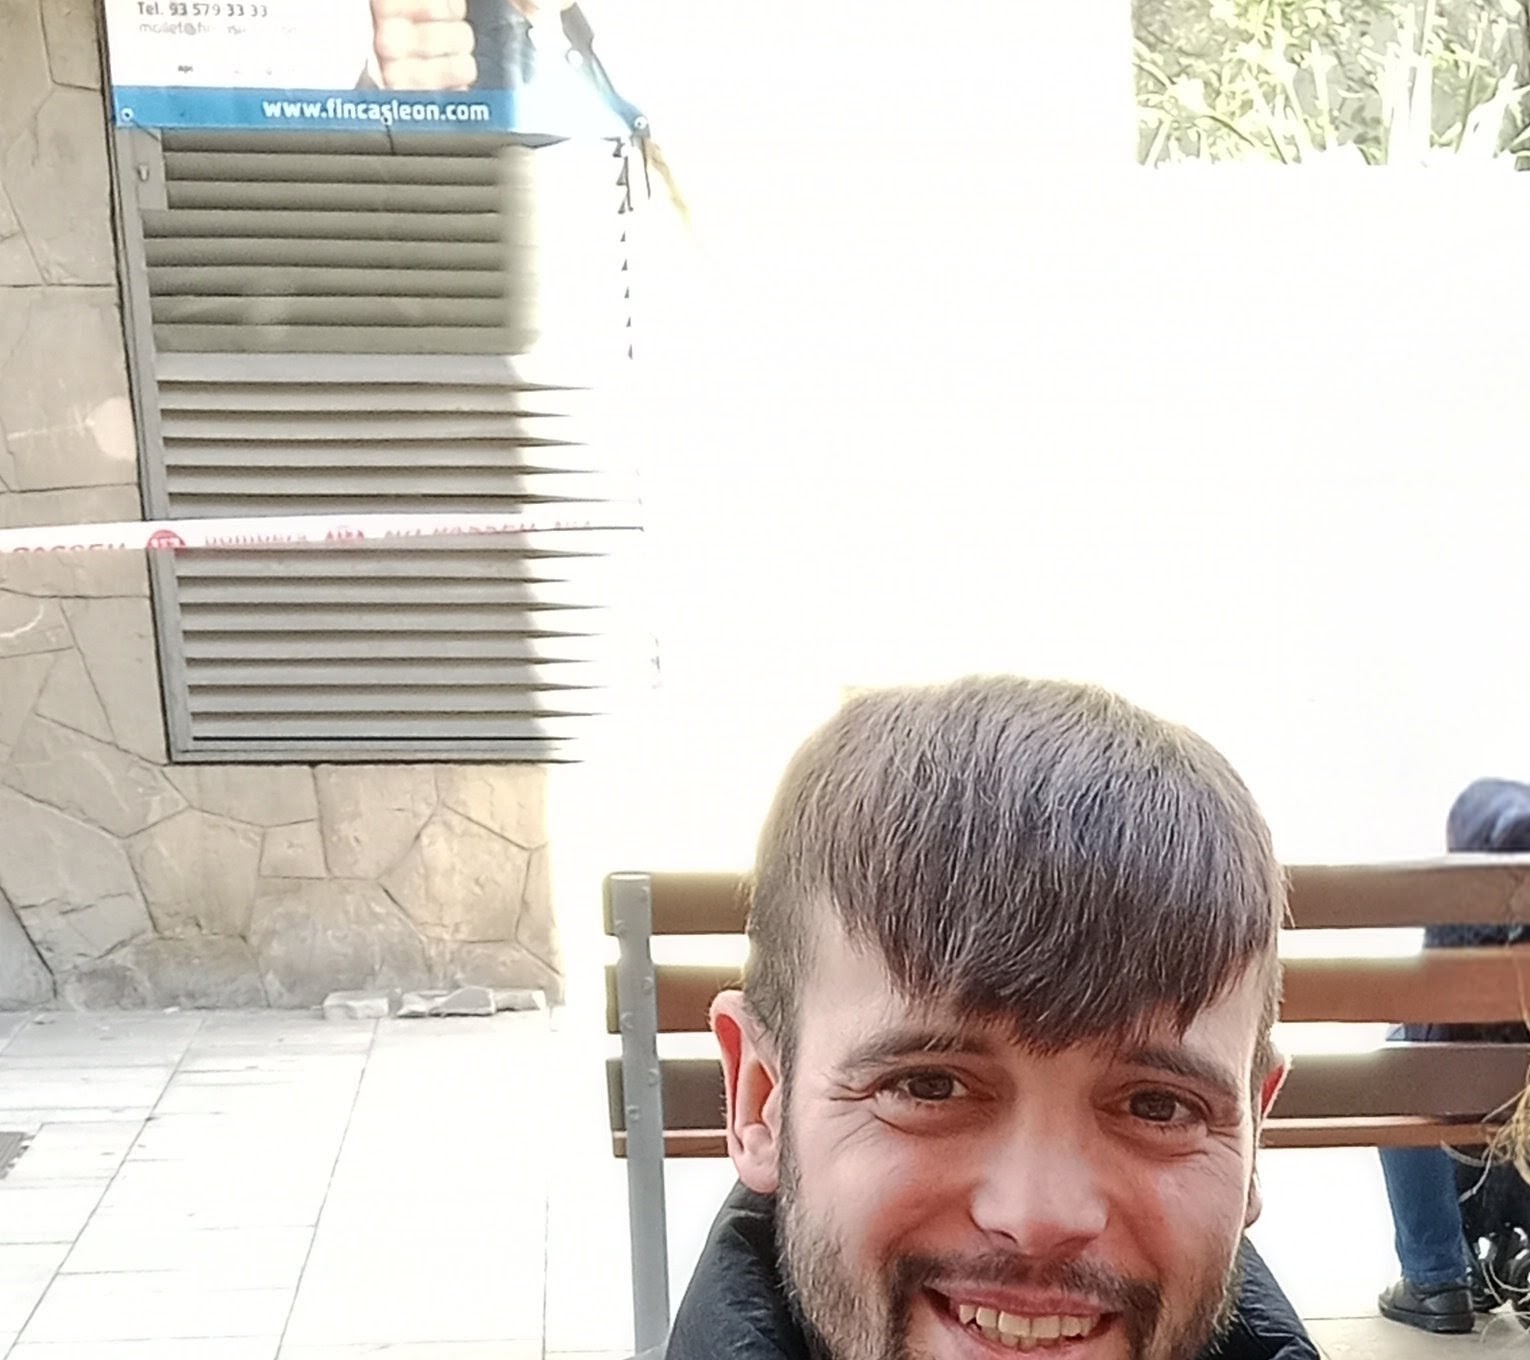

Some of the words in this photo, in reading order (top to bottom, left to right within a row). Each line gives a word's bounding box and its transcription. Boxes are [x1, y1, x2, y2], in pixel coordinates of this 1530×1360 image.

[137, 1, 164, 16] Tel.
[169, 2, 188, 16] 93
[192, 3, 221, 16] 579
[226, 3, 245, 17] 33
[262, 98, 490, 123] www.fincasleon.com
